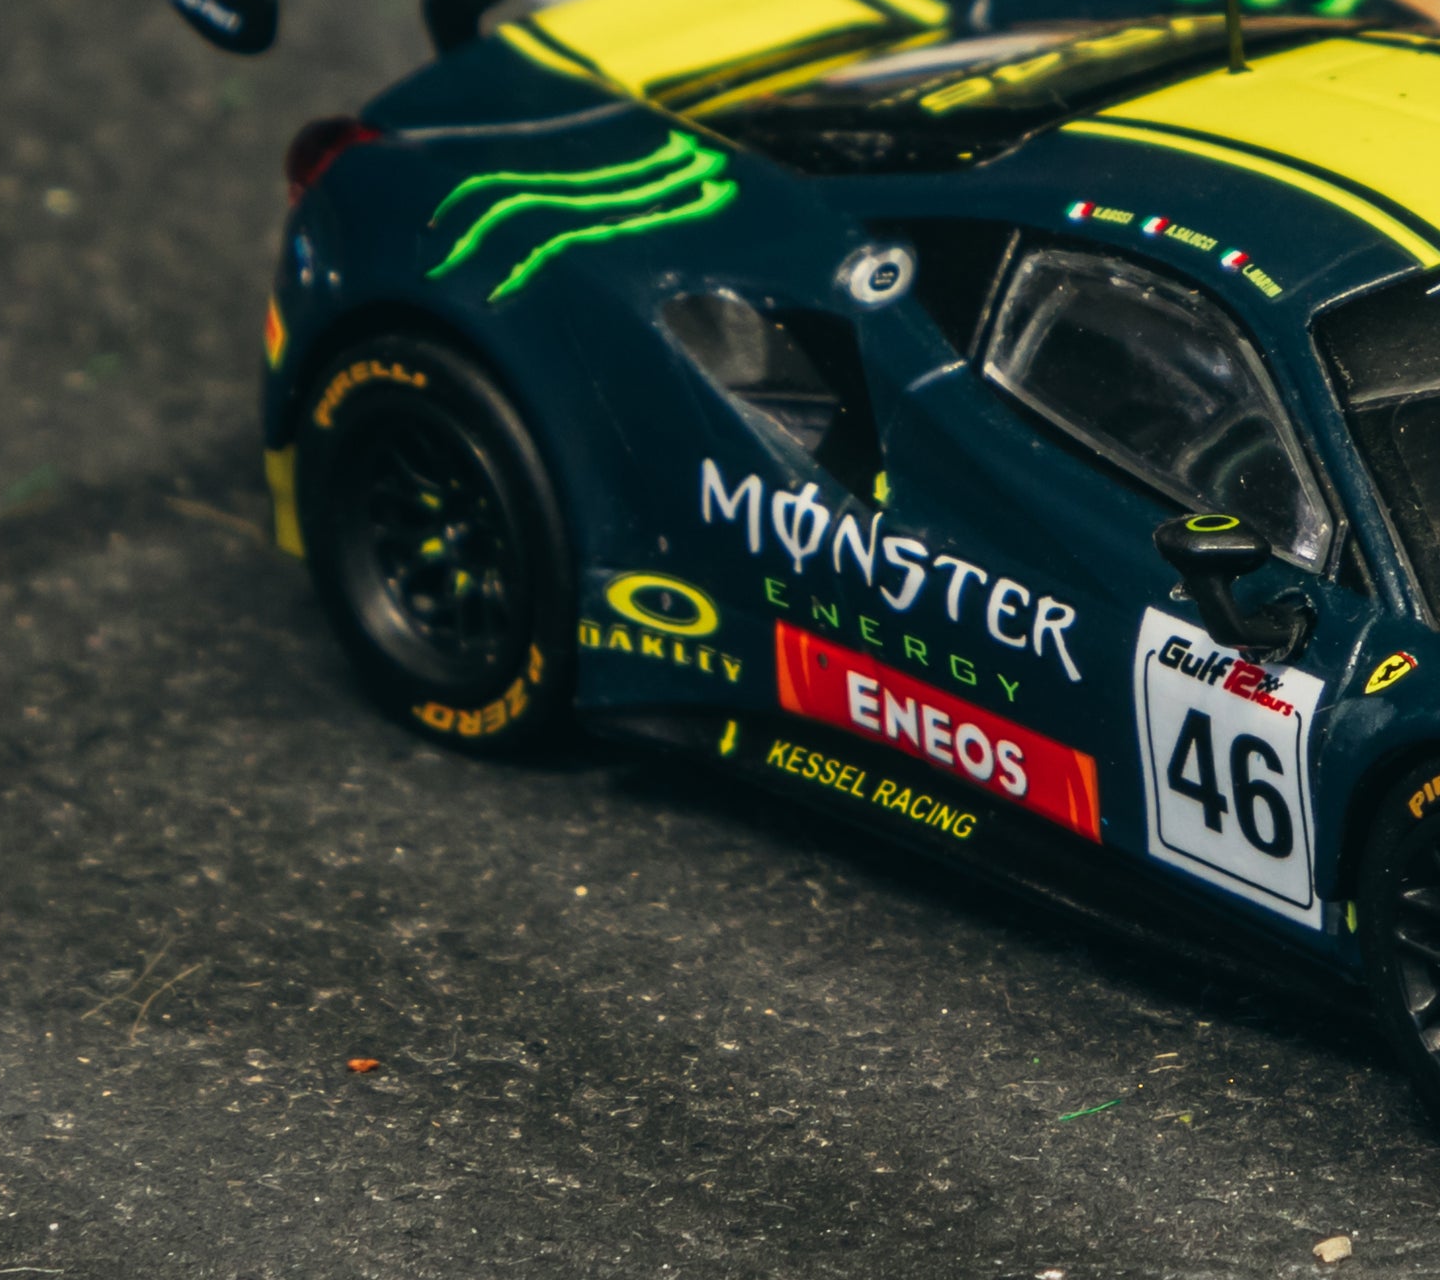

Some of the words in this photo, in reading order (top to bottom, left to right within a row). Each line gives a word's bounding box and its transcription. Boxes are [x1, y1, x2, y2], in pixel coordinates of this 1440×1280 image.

[578, 619, 742, 684] OAKLEY
[763, 576, 1021, 704] ENERGY
[1158, 635, 1237, 686] Gulf
[766, 740, 866, 799] KESSEL
[871, 777, 977, 840] RACING
[846, 670, 1029, 797] ENEOS
[1166, 708, 1295, 860] 46
